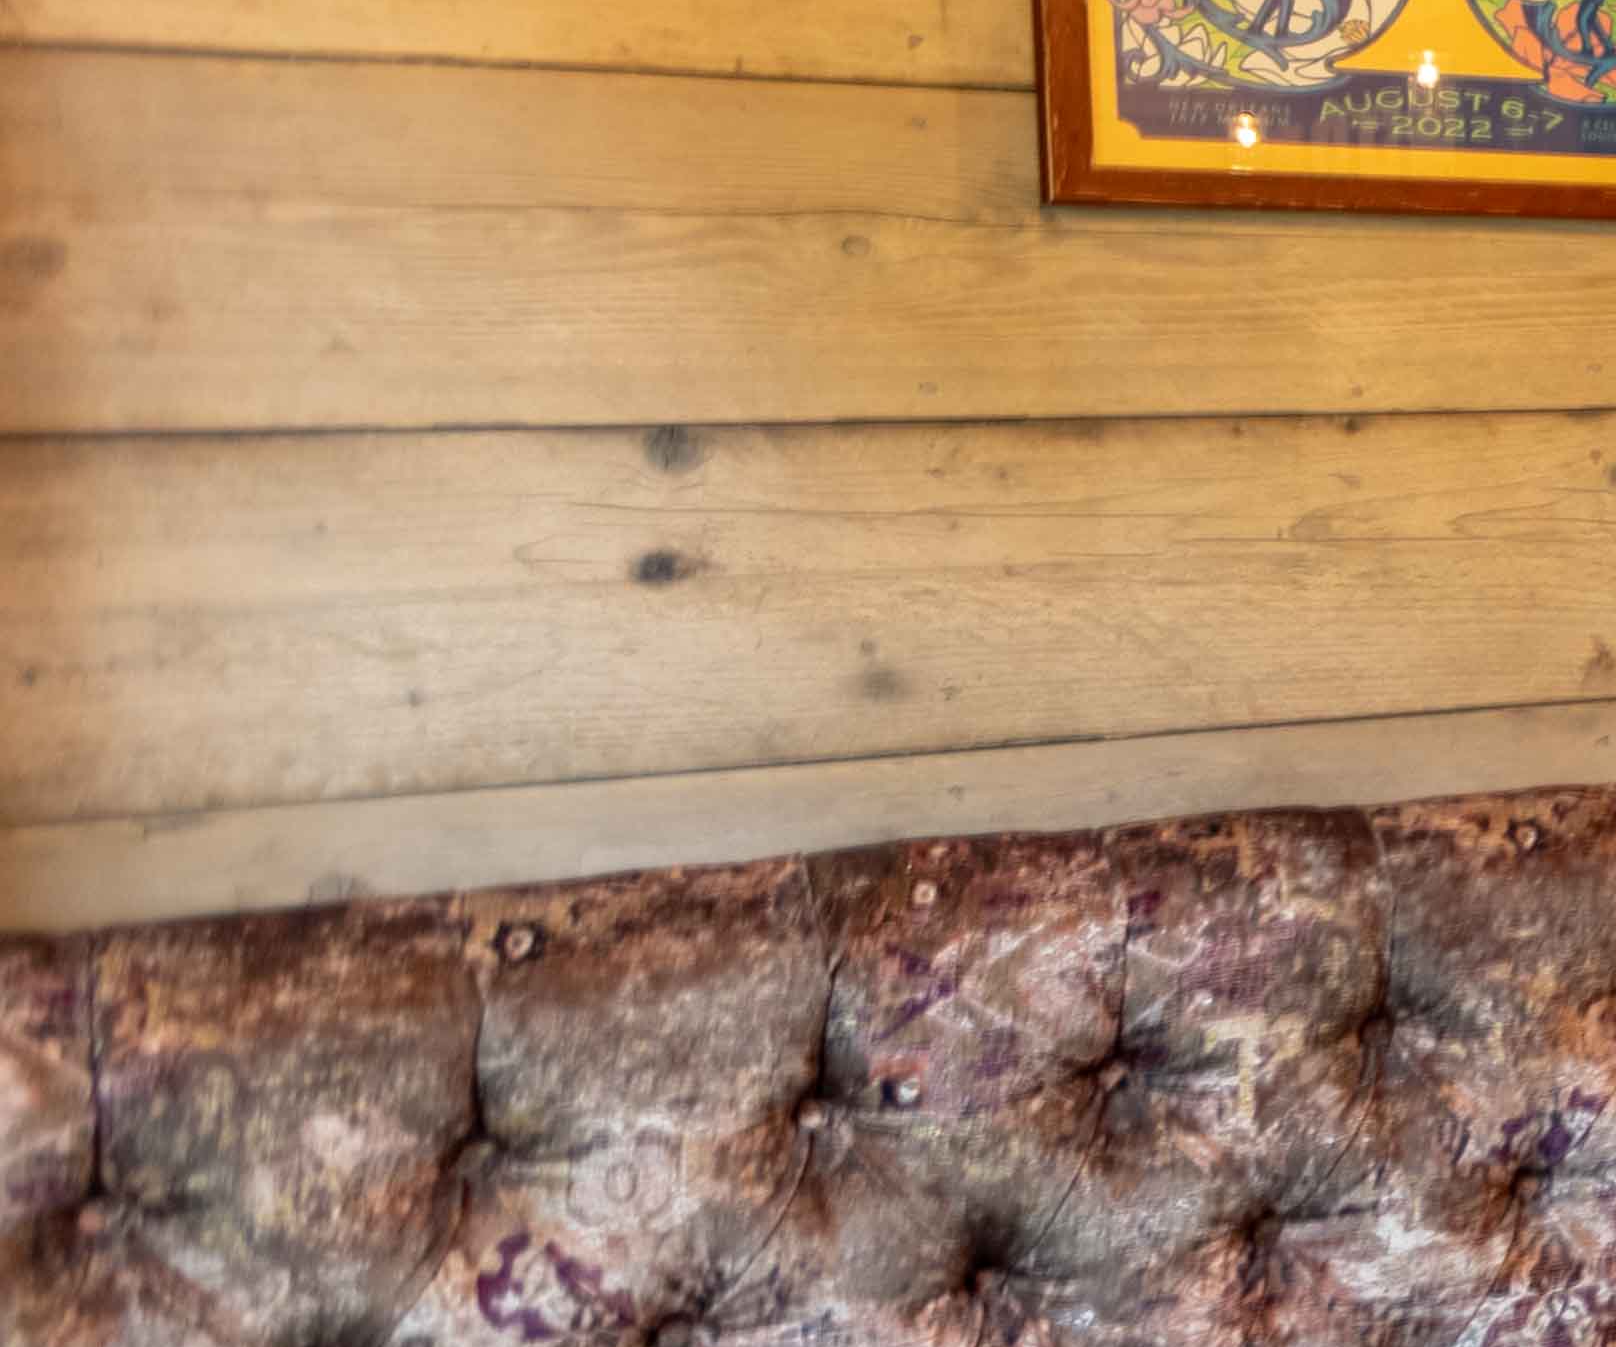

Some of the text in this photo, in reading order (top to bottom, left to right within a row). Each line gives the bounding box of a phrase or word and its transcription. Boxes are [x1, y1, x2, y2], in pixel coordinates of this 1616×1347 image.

[1318, 85, 1491, 125] AUGUST
[1501, 99, 1565, 131] 6-7
[1390, 115, 1493, 140] 2022
